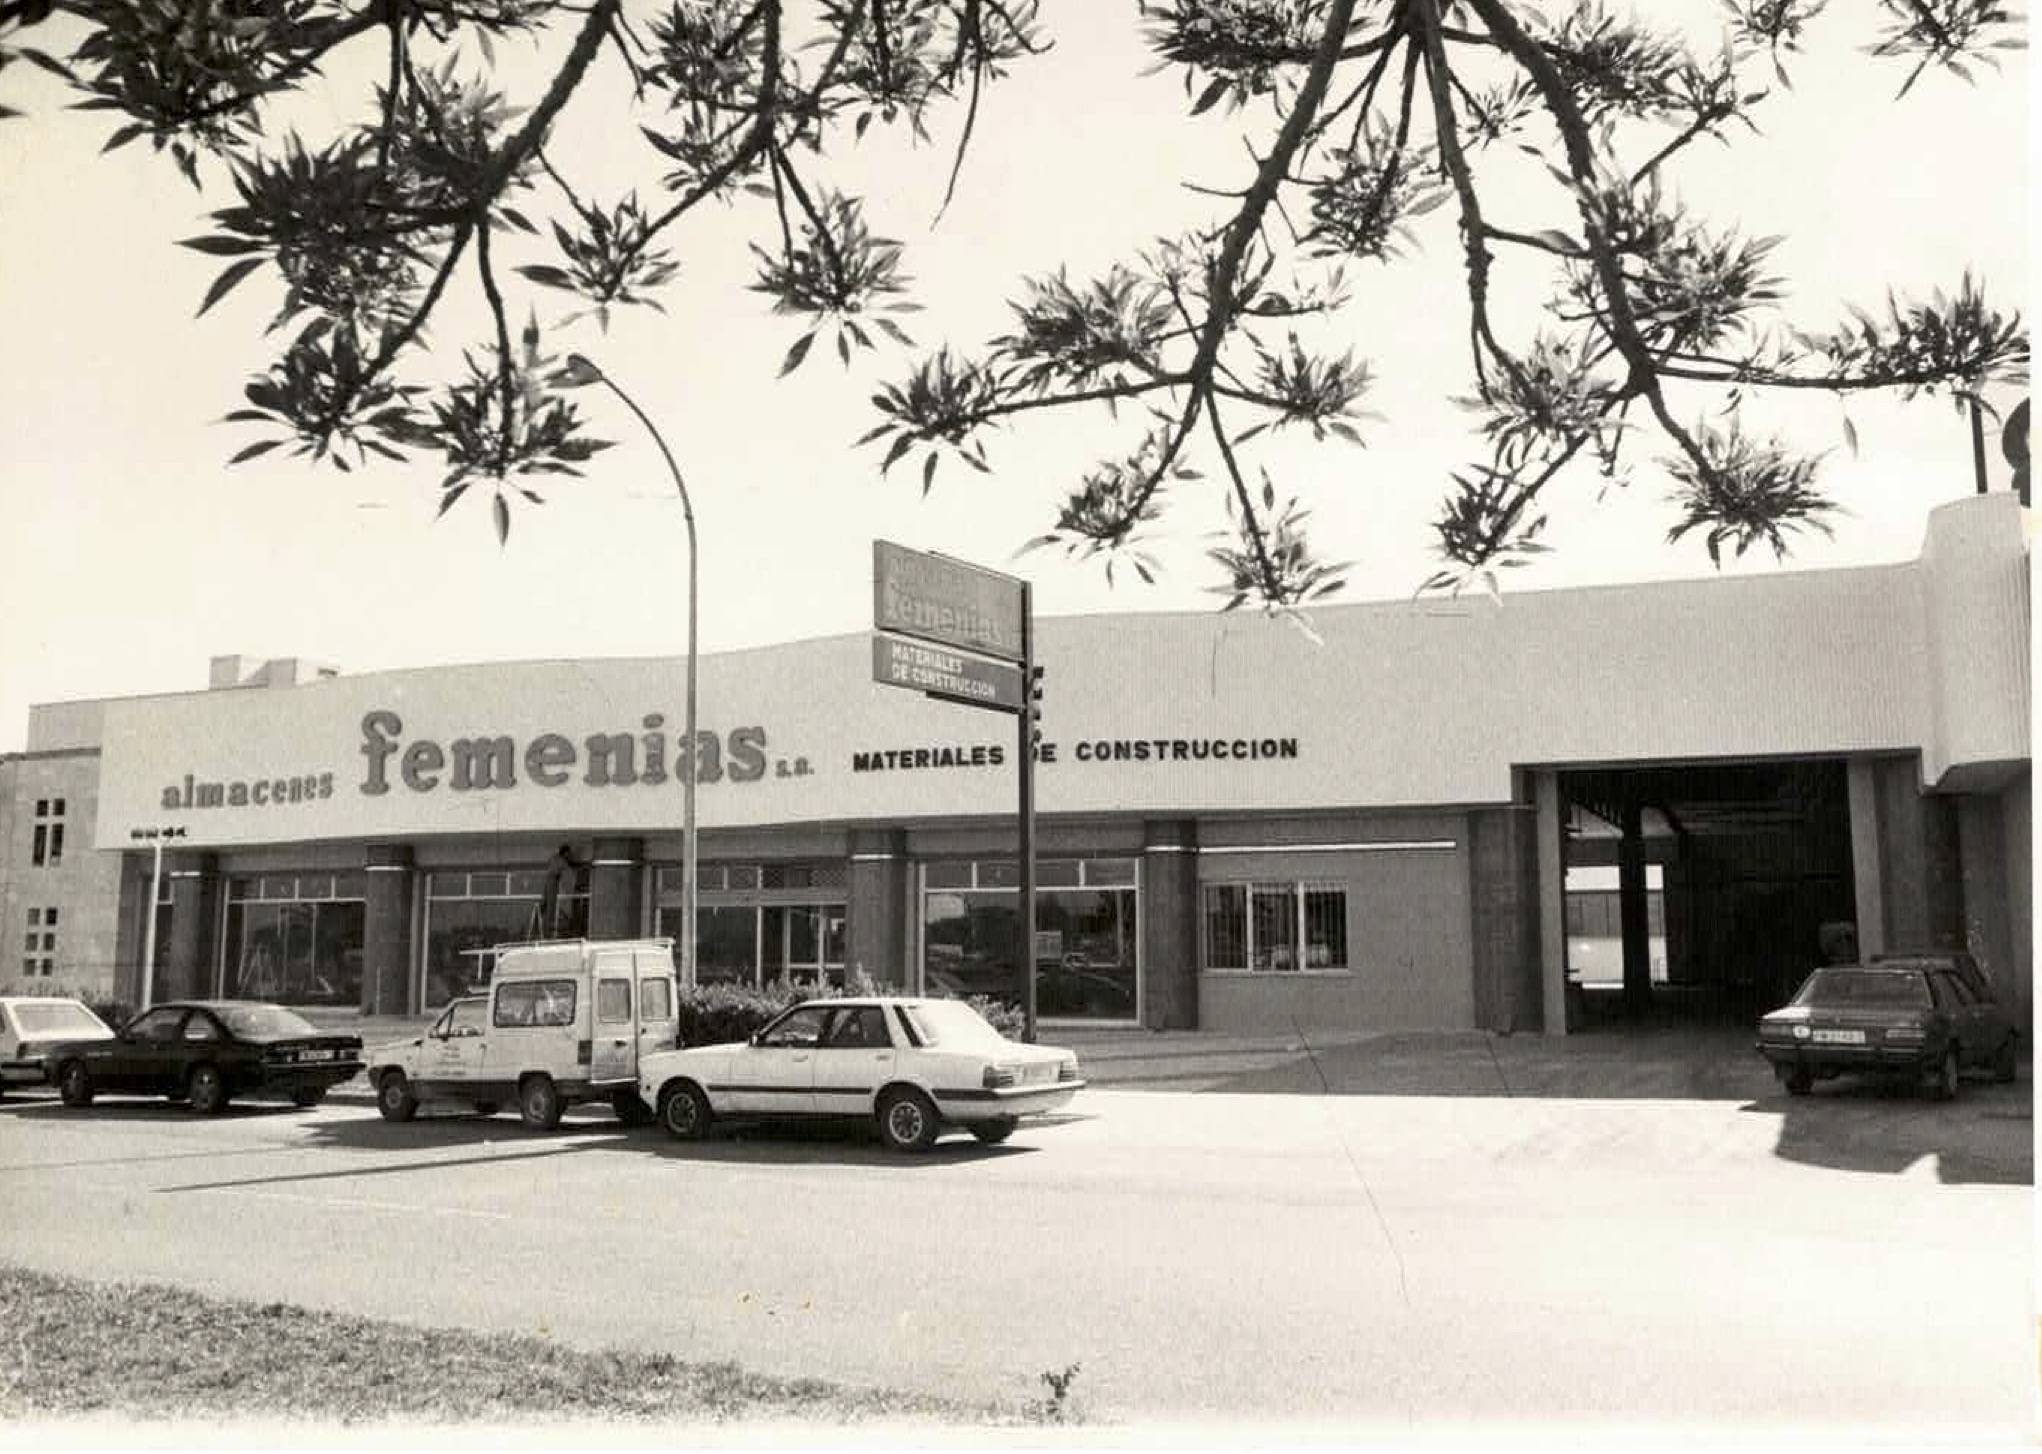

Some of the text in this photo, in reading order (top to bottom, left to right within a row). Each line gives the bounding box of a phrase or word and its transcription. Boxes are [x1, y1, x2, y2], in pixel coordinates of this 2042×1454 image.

[892, 641, 962, 674] MATERIALES
[892, 662, 908, 681] DE
[161, 771, 334, 810] almacenes
[358, 710, 767, 797] femenias
[853, 744, 1005, 773] MATERIALES
[1075, 738, 1299, 763] CONSTRUCCION
